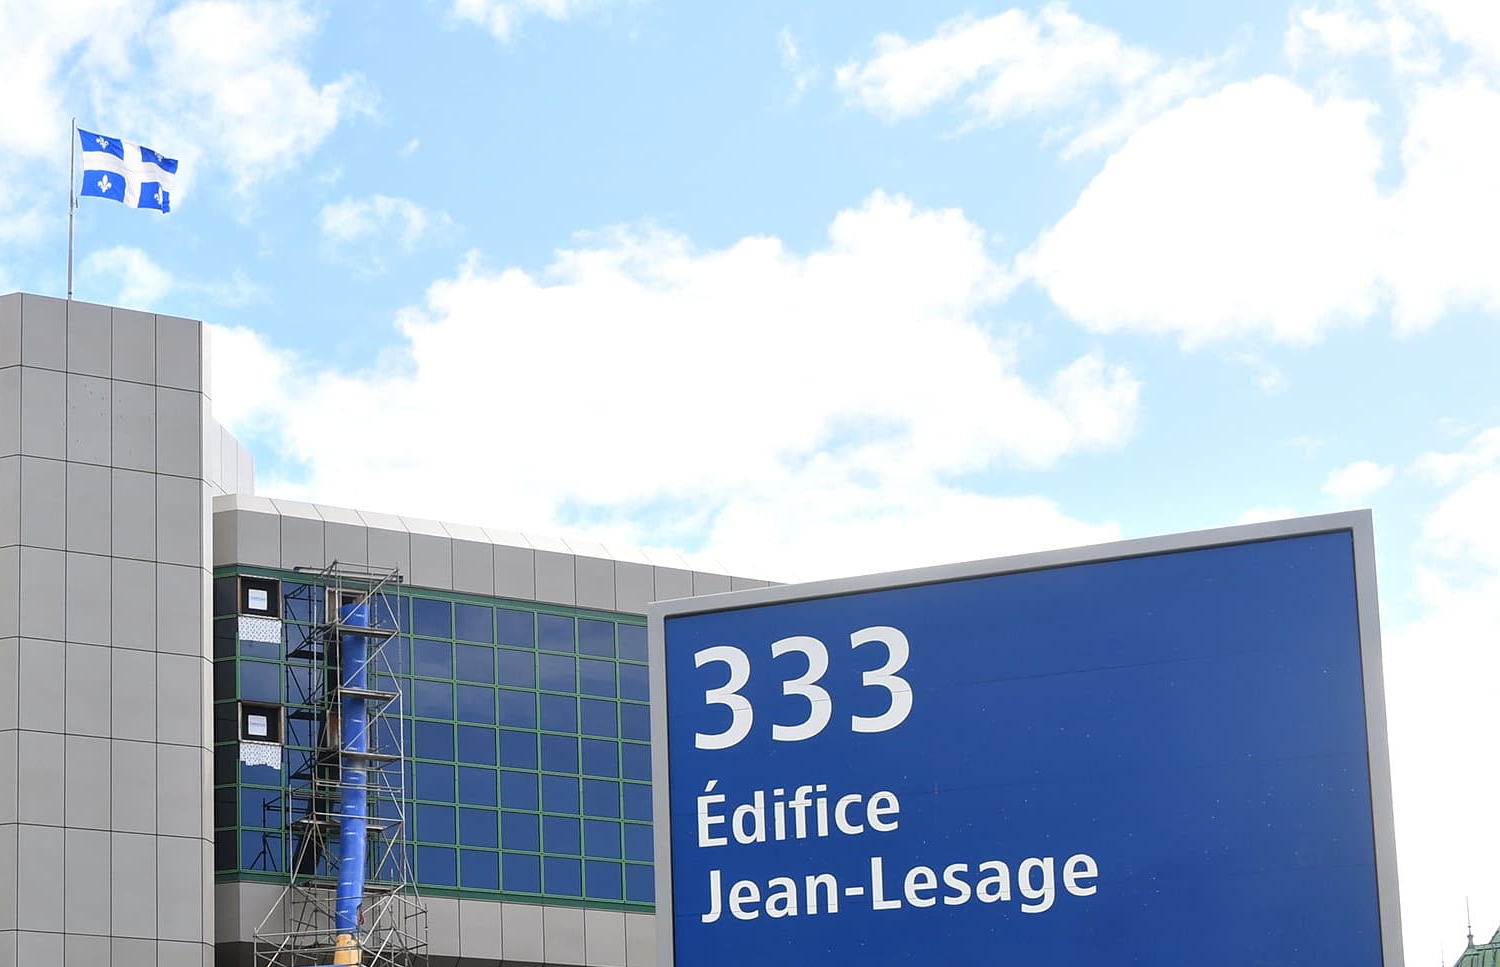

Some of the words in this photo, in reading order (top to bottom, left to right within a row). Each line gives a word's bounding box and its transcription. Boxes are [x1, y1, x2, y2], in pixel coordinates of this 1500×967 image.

[695, 625, 913, 750] 333
[697, 780, 900, 848] Édifice
[701, 853, 1099, 923] Jean-Lesage
